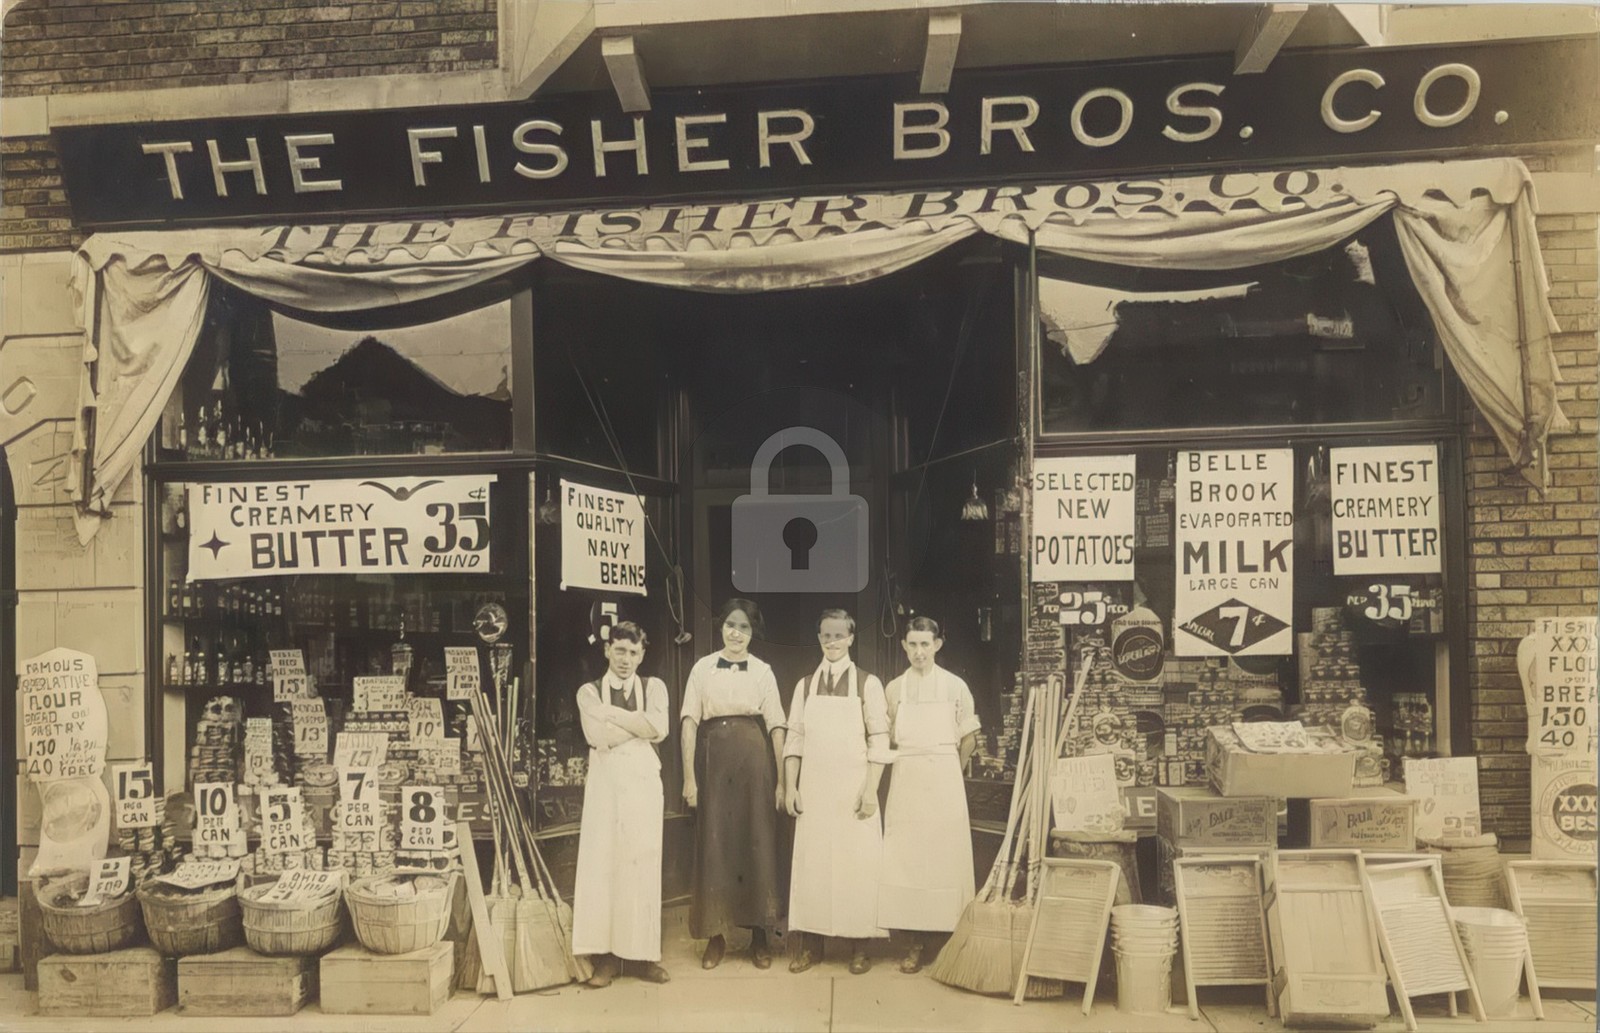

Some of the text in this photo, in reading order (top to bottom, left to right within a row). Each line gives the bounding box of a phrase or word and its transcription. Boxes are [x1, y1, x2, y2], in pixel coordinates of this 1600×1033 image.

[142, 62, 1510, 200] THE FISHER BROS. CO.
[493, 194, 867, 243] FISHER
[1188, 452, 1268, 472] BELLE
[1336, 459, 1433, 485] FINEST
[1035, 472, 1135, 492] SELECTED
[1189, 480, 1279, 503] BROOK
[202, 484, 311, 505] FINEST
[568, 486, 625, 514] FINEST
[230, 502, 375, 527] CREAMERY
[1057, 498, 1111, 519] NEW
[1333, 495, 1435, 518] CREAMERY
[576, 512, 635, 537] QUALITY
[1180, 511, 1293, 529] EVAPORATED
[250, 526, 410, 570] BUTTER
[587, 538, 631, 560] NAVY
[1035, 534, 1134, 567] POTATOES
[1336, 527, 1438, 559] BUTTER
[421, 553, 481, 568] POUND
[1182, 539, 1293, 575] MILK
[600, 561, 646, 588] BEANS
[1189, 577, 1279, 591] LARGE CAN
[26, 659, 84, 675] FAMOUS
[1540, 730, 1575, 747] 40
[118, 769, 153, 801] 15
[200, 786, 227, 817] 10
[122, 811, 149, 824] CAN
[345, 814, 375, 827] CAN
[201, 828, 231, 842] CAN
[269, 833, 301, 850] CAN
[408, 835, 436, 846] CAN
